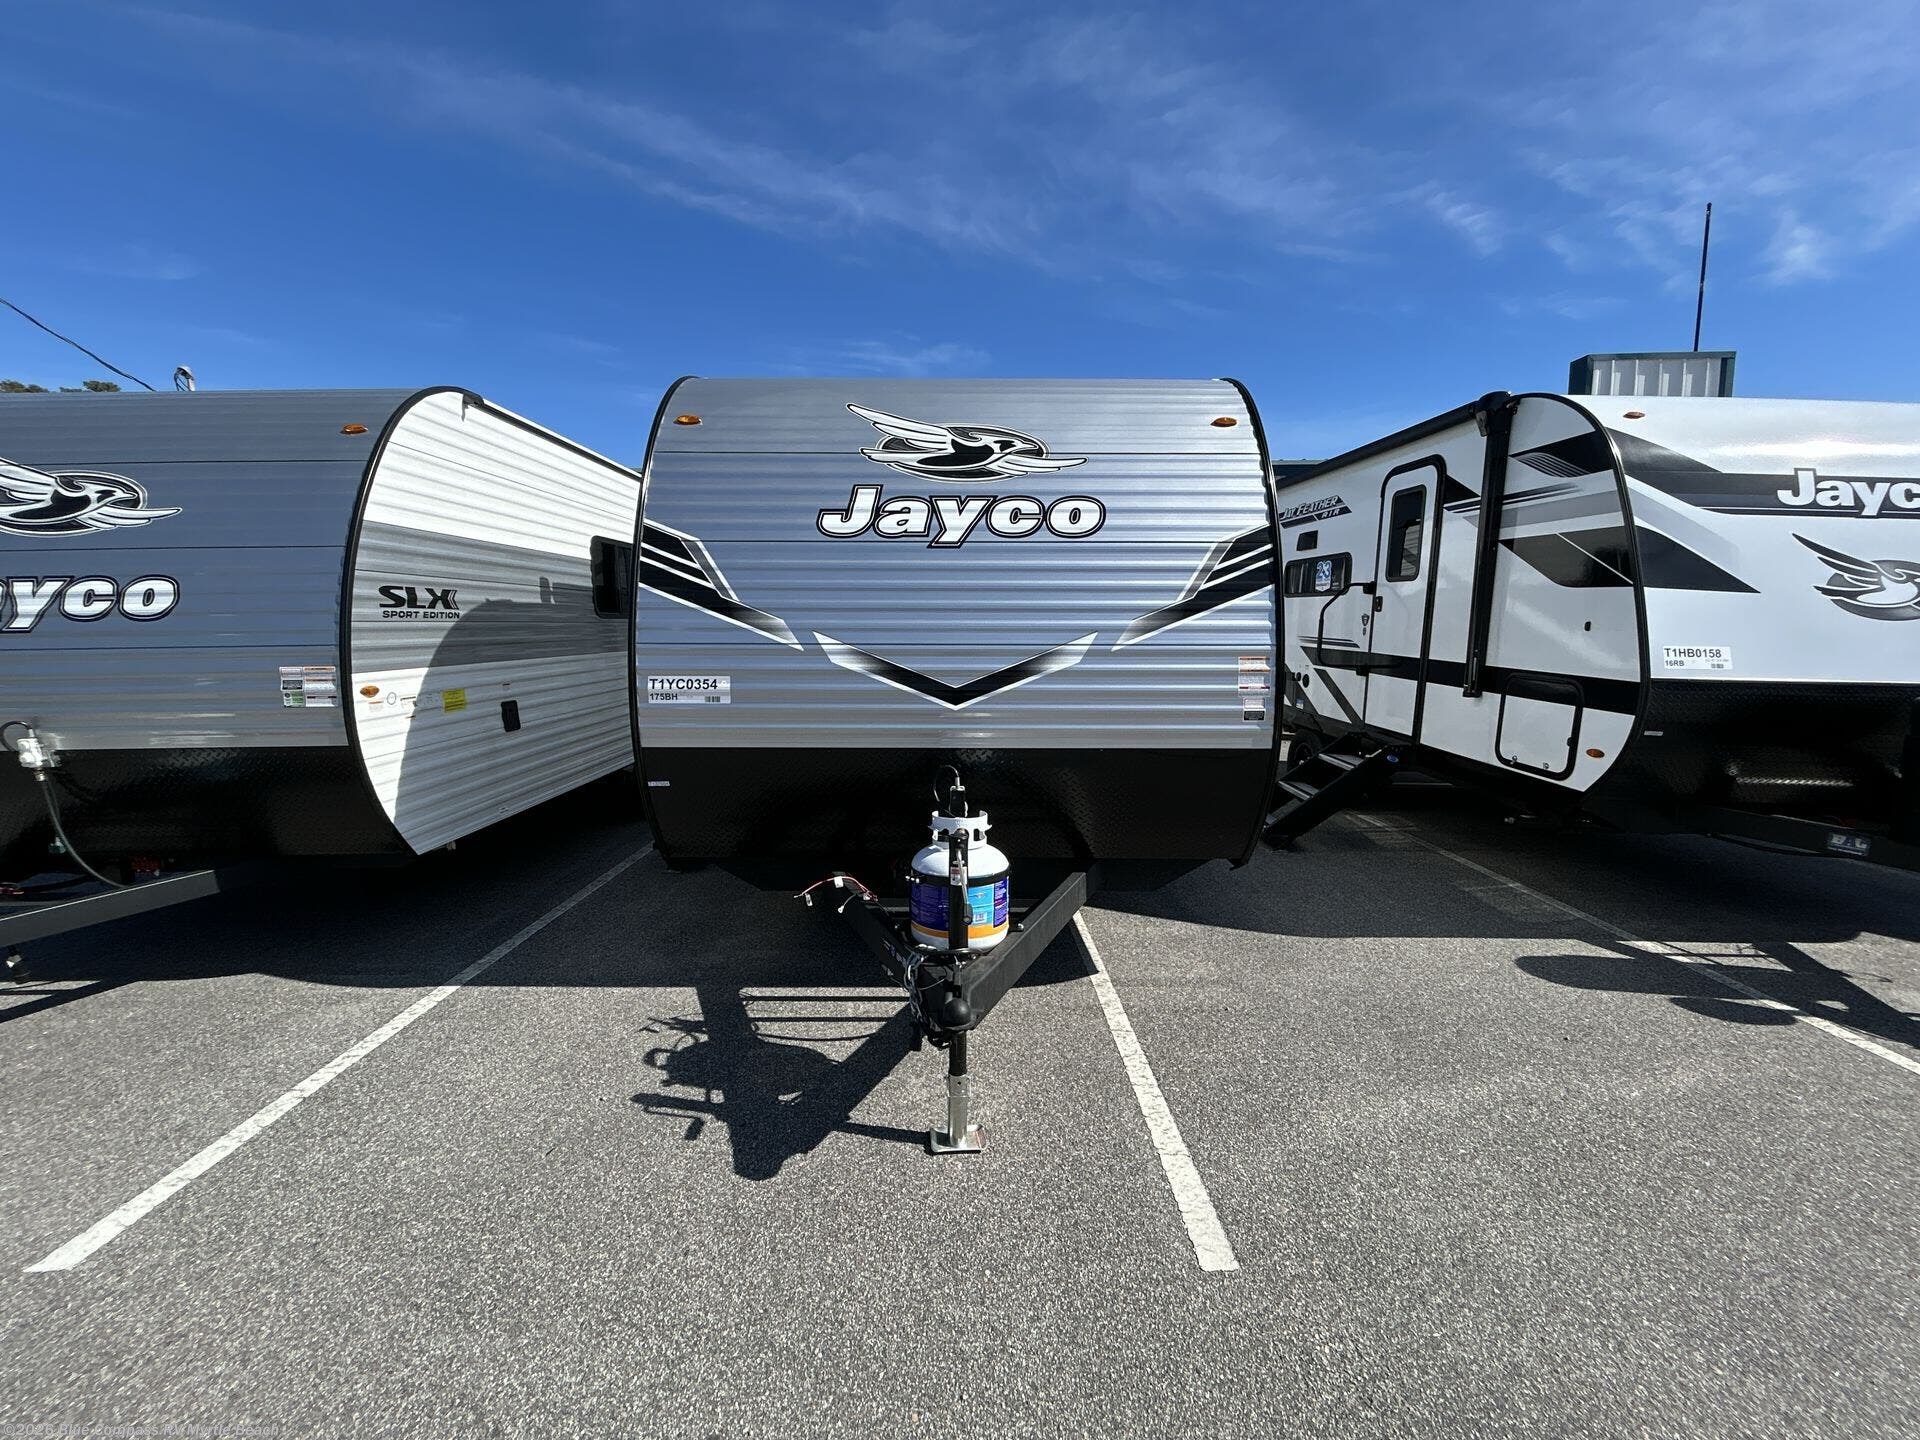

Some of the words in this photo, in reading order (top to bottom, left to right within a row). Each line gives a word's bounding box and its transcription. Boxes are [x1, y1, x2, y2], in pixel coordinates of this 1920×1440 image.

[1296, 495, 1338, 516] FEATHER
[816, 484, 1107, 549] Jayco
[1321, 508, 1340, 519] AIR
[378, 585, 460, 610] SLX
[0, 574, 180, 634] yco
[382, 610, 420, 619] SPORT
[422, 611, 460, 619] EDITION
[1664, 648, 1722, 658] T1HB0158
[649, 678, 718, 690] T1YC0354
[650, 692, 678, 701] 175BH
